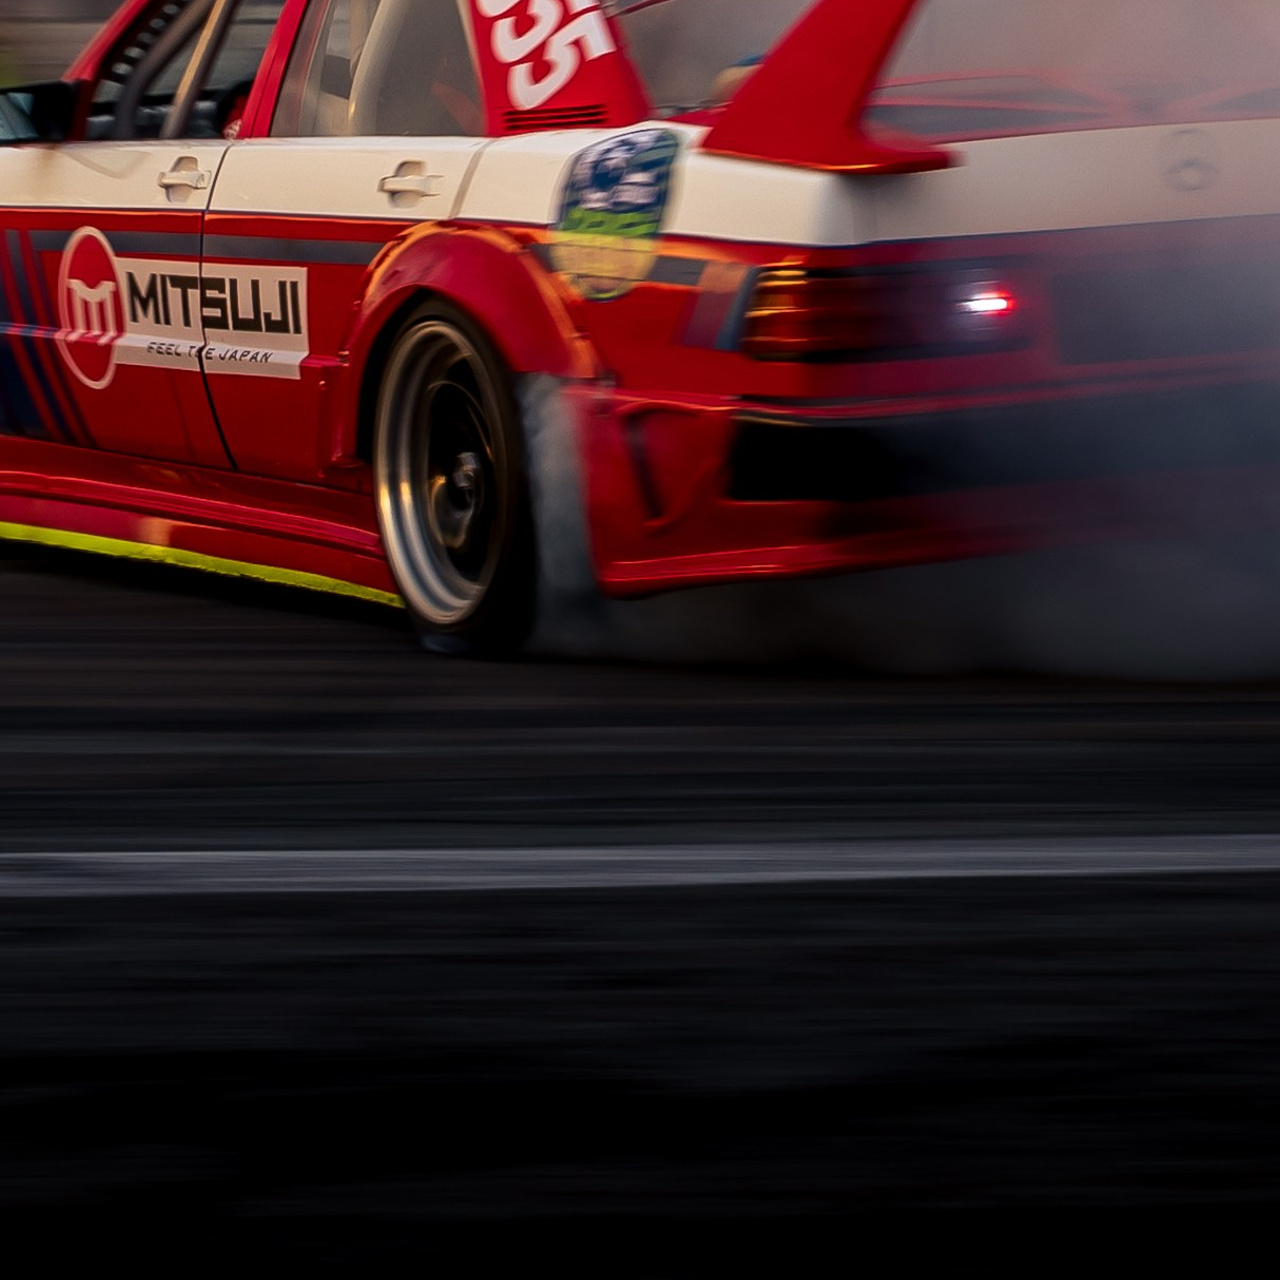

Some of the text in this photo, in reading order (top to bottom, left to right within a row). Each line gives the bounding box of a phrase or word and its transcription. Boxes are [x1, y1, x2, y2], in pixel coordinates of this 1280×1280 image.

[126, 271, 303, 335] MITSUJI
[146, 341, 182, 357] FEEL
[218, 348, 274, 364] JAPAN
